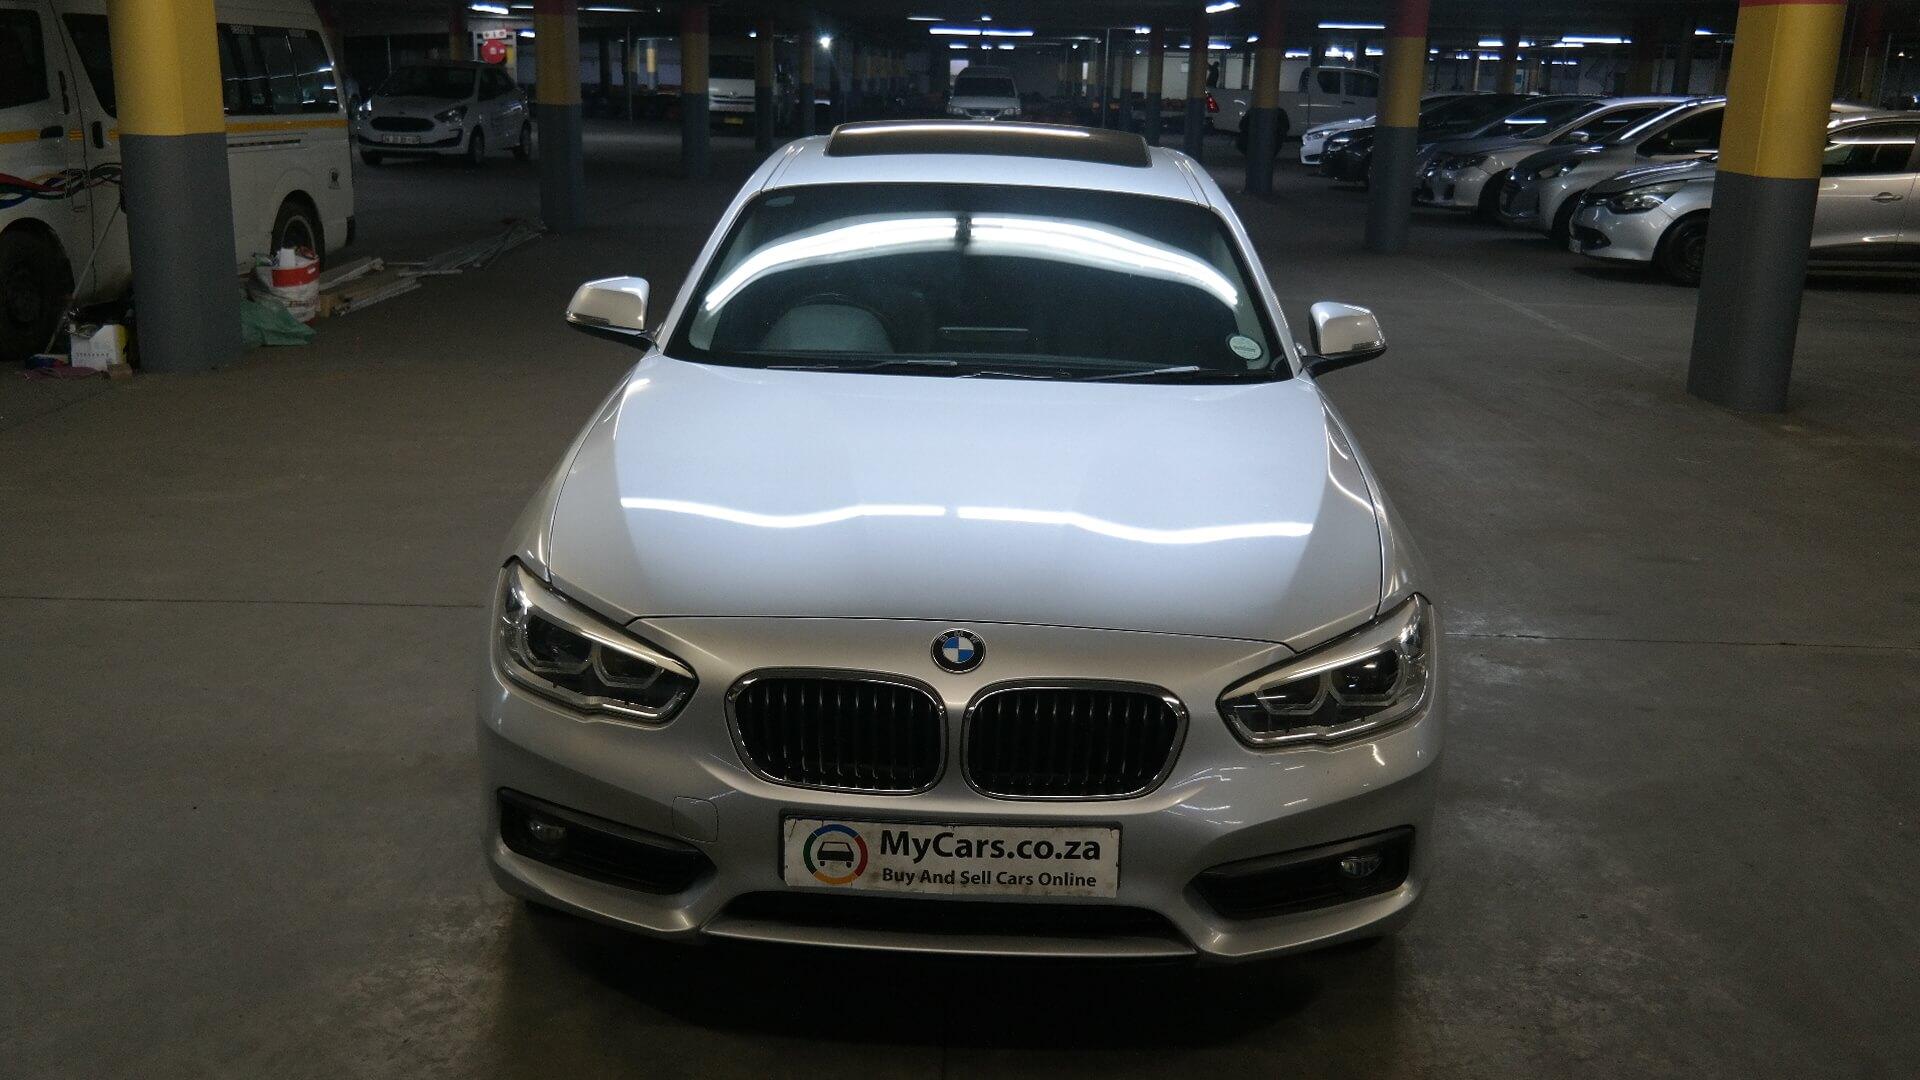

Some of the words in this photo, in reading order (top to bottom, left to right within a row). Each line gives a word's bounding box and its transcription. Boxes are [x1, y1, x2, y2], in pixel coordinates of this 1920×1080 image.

[939, 631, 980, 644] BMW
[880, 829, 1101, 864] MyCars.co.za
[882, 867, 915, 886] Buy
[919, 869, 955, 885] And
[960, 870, 991, 886] Sell
[997, 872, 1034, 886] Cars
[1038, 873, 1097, 887] Online
